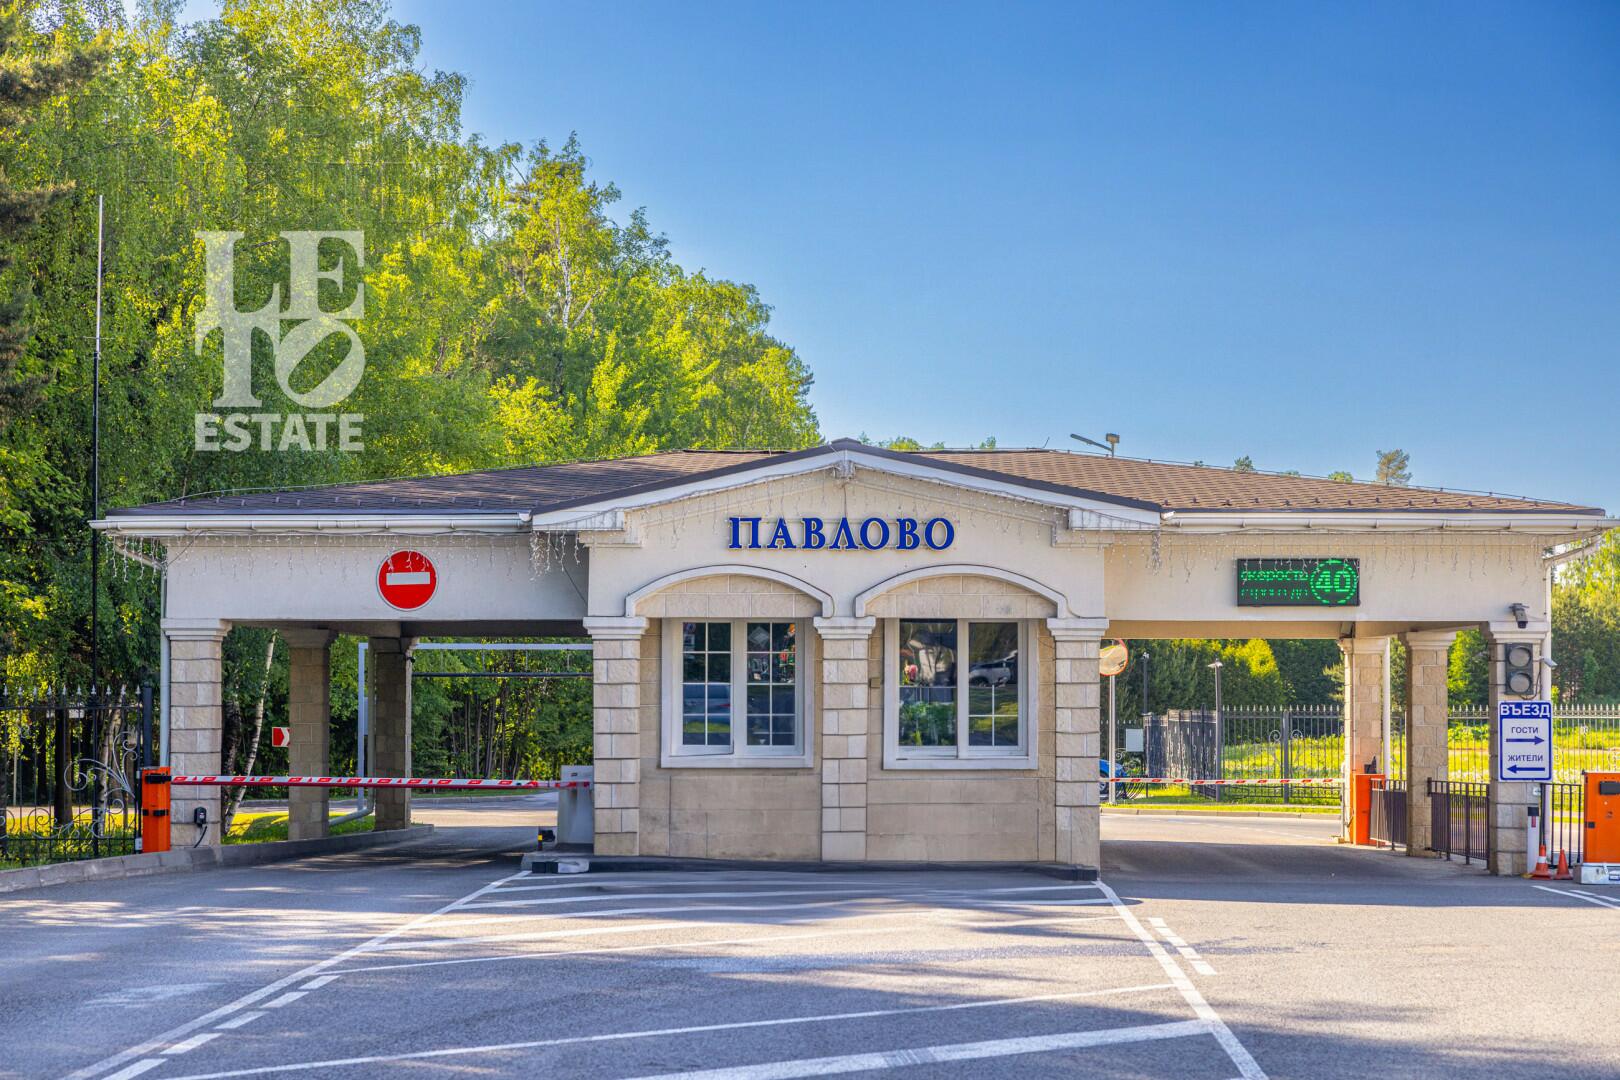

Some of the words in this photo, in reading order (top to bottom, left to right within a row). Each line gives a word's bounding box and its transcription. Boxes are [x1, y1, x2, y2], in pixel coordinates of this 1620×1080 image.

[729, 517, 955, 550] ПАВЛОВО
[1315, 570, 1351, 592] 40
[1501, 704, 1550, 717] ВЪЕЗД
[1511, 726, 1539, 734] ГОСТИ
[1507, 754, 1544, 762] ЖИТЕЛИ
